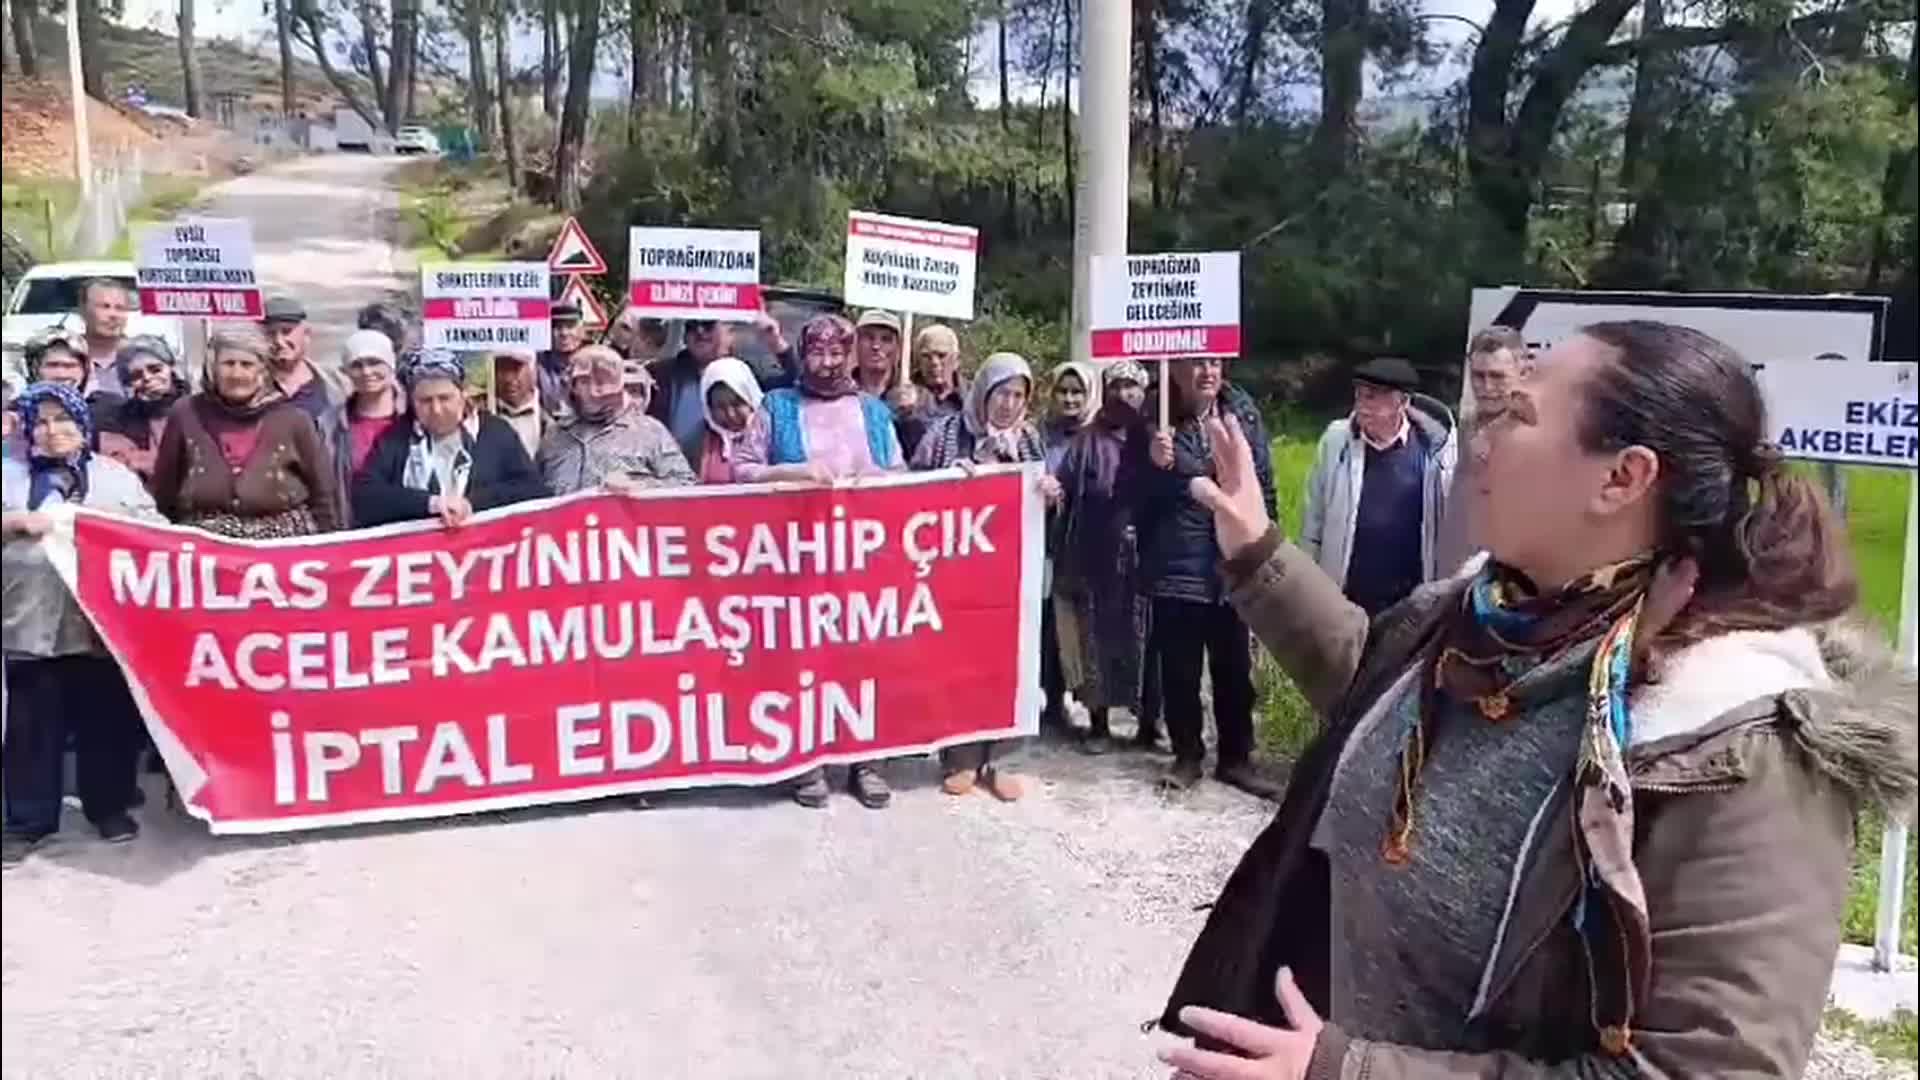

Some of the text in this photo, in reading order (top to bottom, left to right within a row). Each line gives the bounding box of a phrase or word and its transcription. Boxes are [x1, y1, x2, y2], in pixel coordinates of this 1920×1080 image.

[639, 245, 755, 270] TOPRAĞIMIZDAN
[1127, 254, 1201, 276] TOPRAĞIMA
[1131, 277, 1196, 298] ZEYTİNİME
[1126, 301, 1202, 321] GELECEĞİME
[108, 504, 997, 611] MİLAS ZEYTİNİNE SAHİP ÇIK
[184, 583, 943, 691] ACELE KAMULAŞTIRMA
[269, 670, 879, 806] İPTAL EDİLSİN
